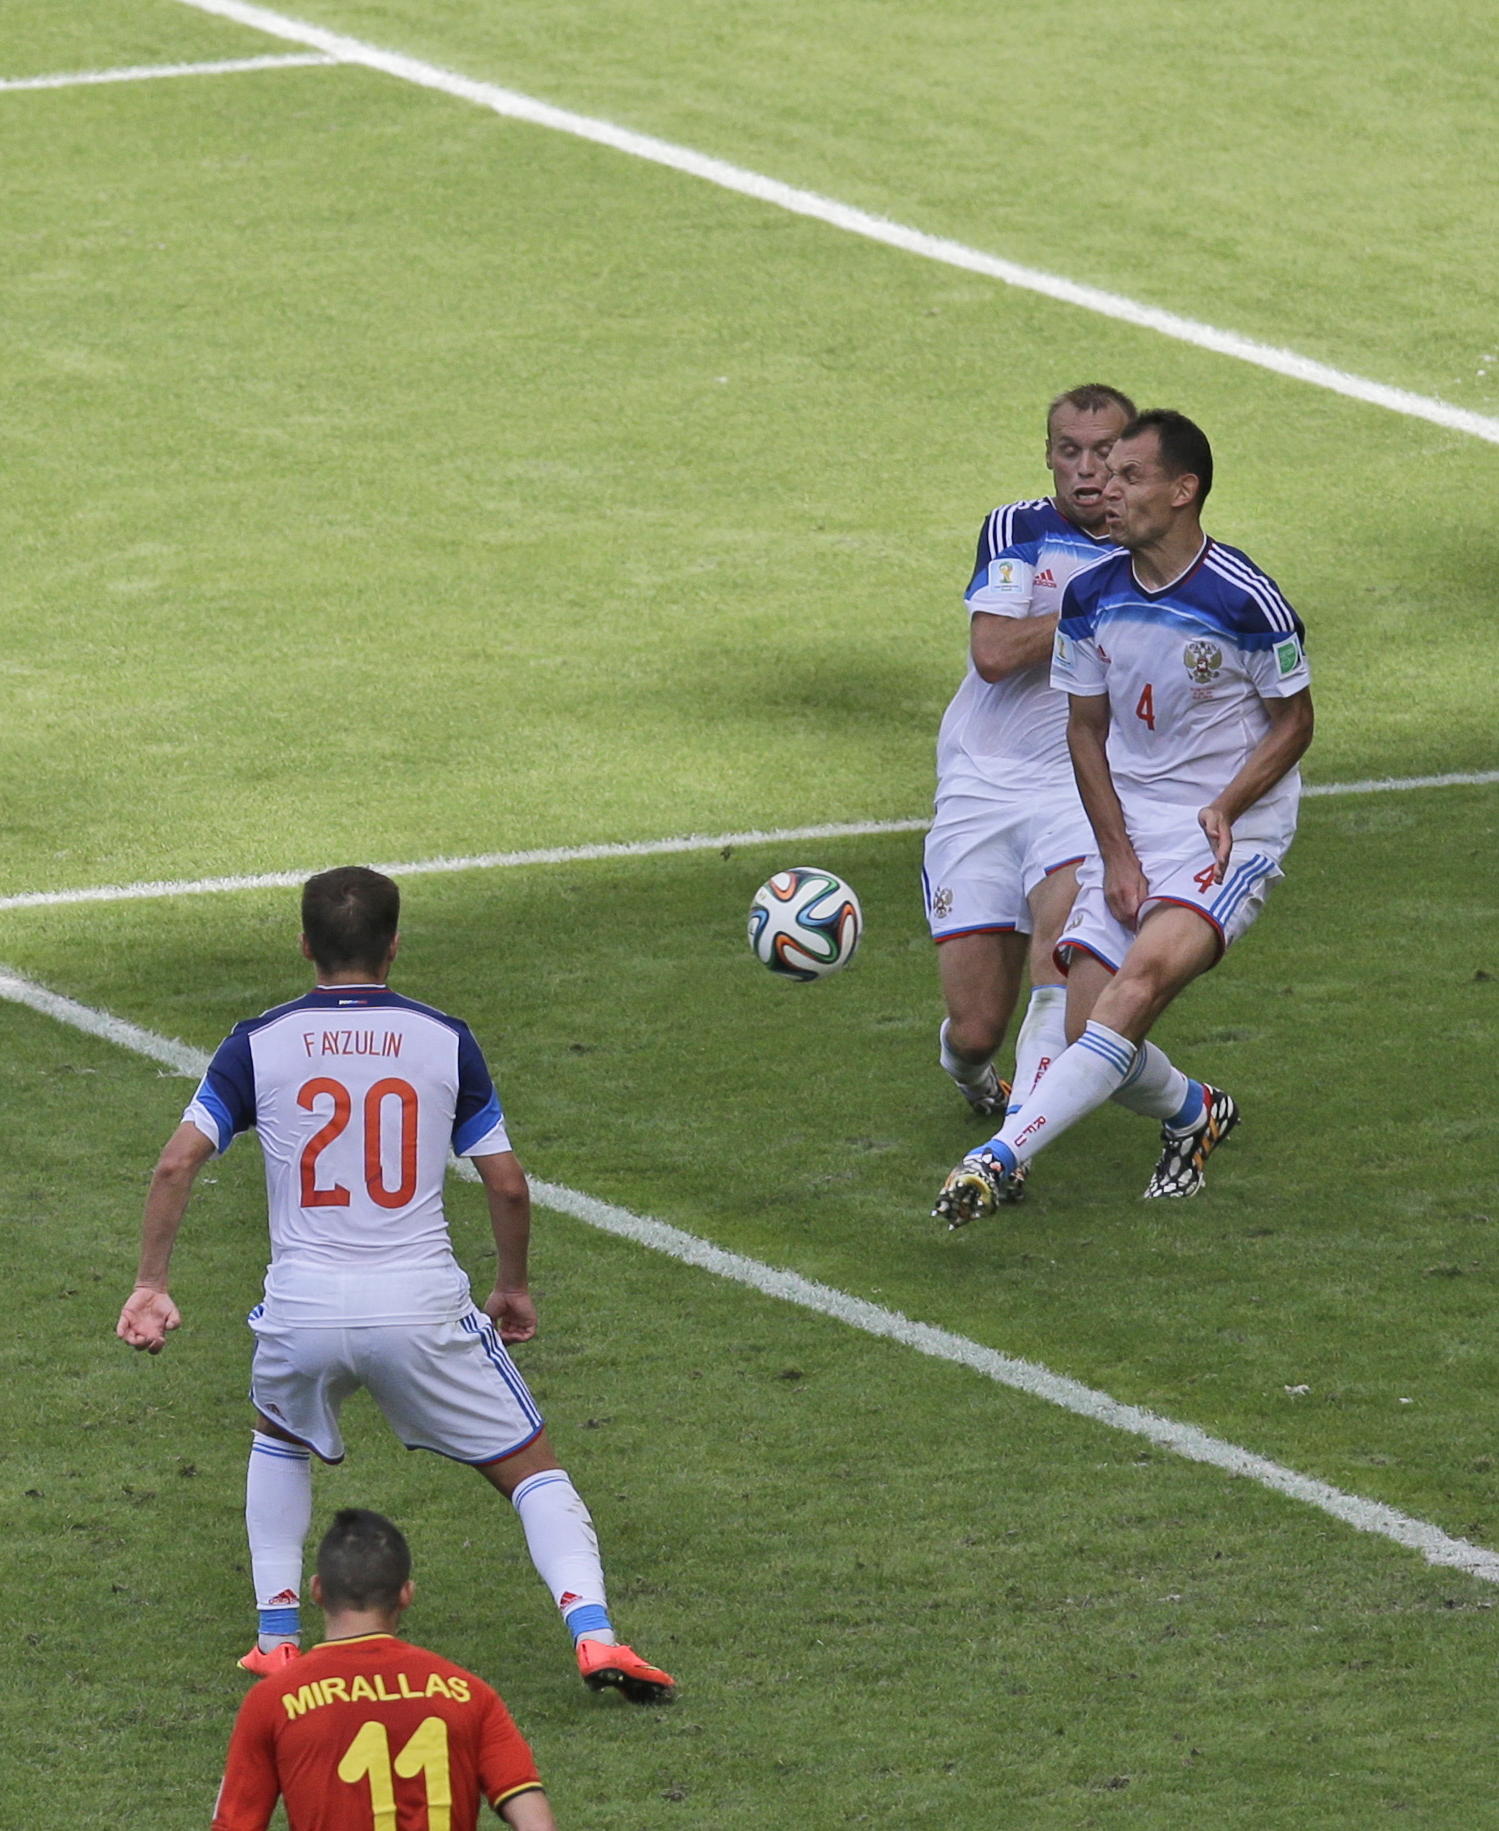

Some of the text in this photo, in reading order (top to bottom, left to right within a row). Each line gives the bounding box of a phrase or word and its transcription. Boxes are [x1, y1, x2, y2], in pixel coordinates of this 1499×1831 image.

[1135, 683, 1155, 731] 4
[1193, 863, 1218, 894] 4
[303, 1031, 402, 1057] FAYZULIN
[296, 1076, 419, 1209] 20
[1014, 1116, 1046, 1147] RFU
[281, 1672, 471, 1720] MIRALLAS
[337, 1716, 452, 1831] 11
